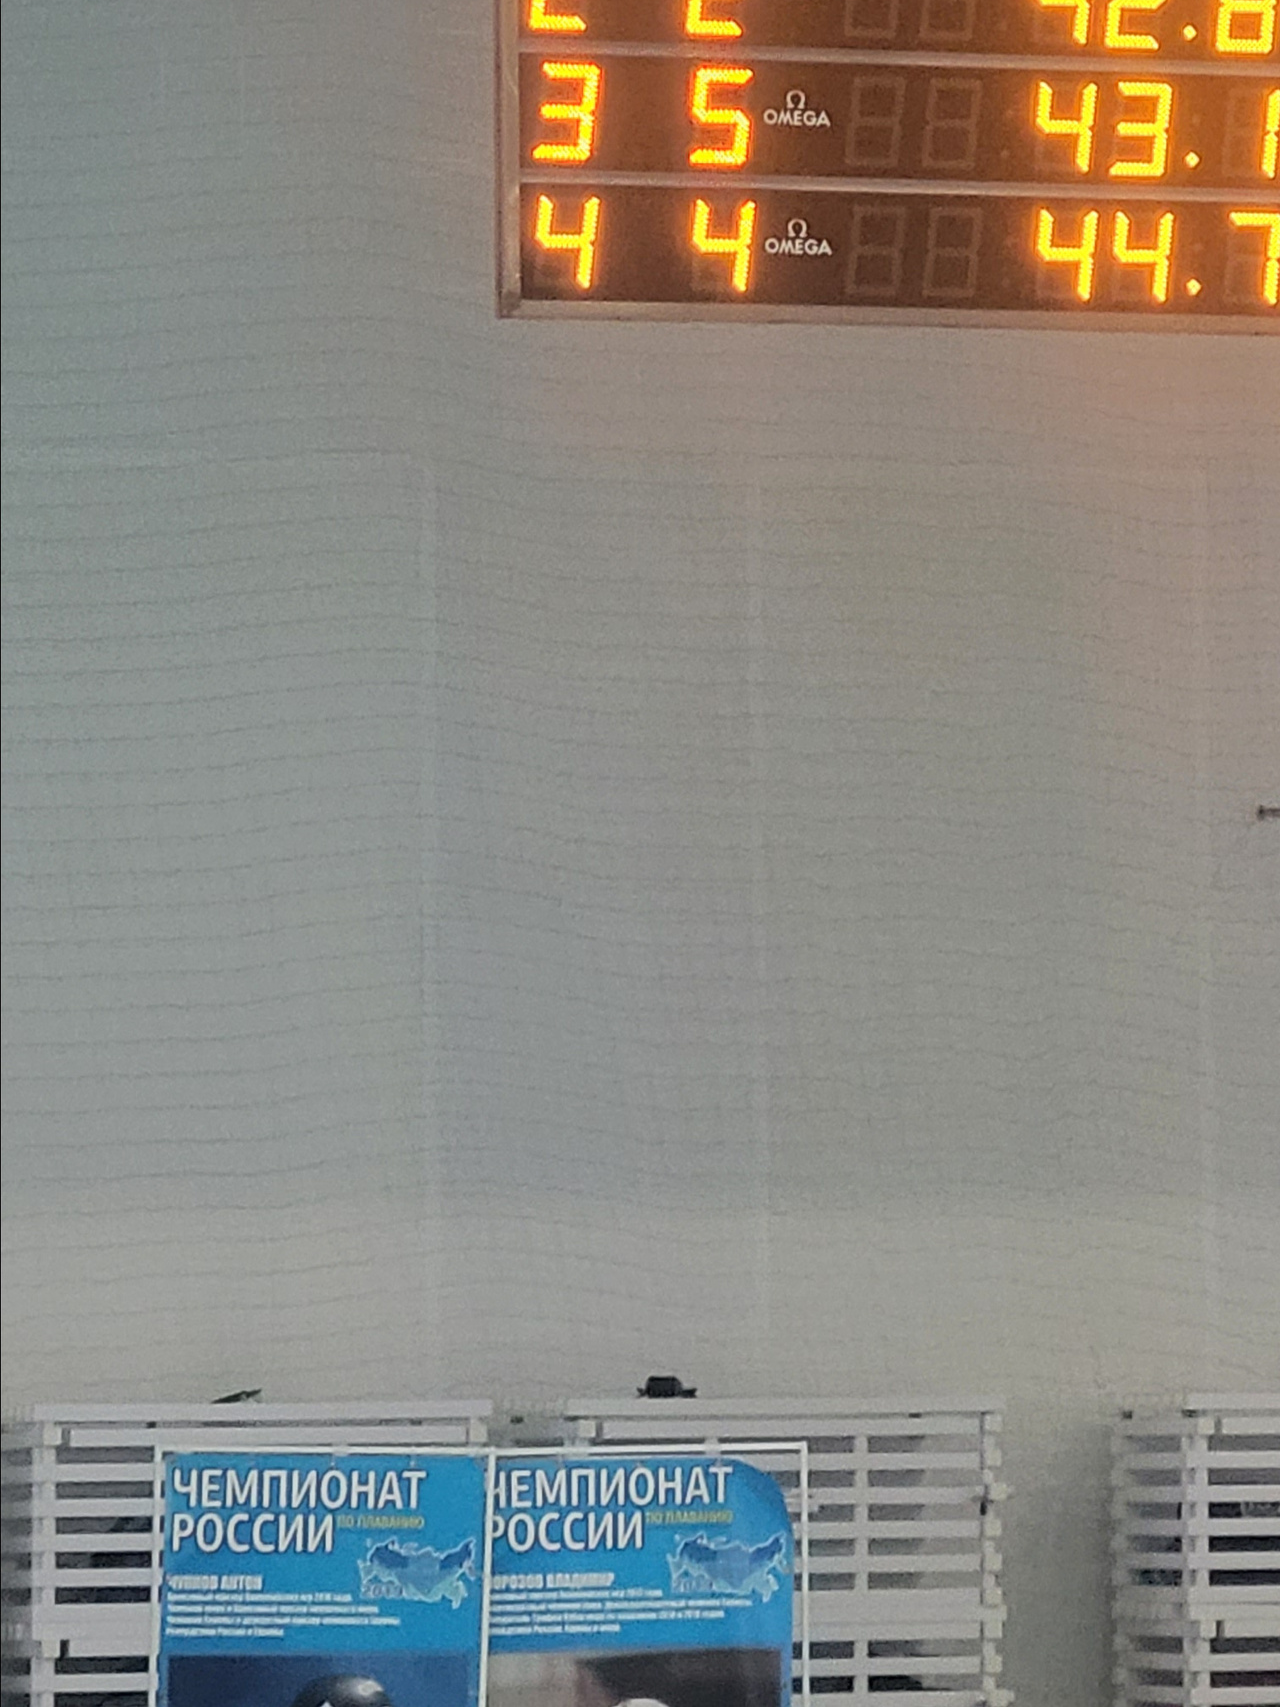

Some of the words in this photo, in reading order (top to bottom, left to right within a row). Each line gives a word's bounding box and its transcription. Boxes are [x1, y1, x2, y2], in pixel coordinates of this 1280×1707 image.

[533, 59, 605, 165] 3
[687, 63, 756, 170] 5
[763, 109, 831, 128] OMEGA
[532, 194, 603, 290] 4
[689, 198, 758, 293] 4
[764, 237, 833, 257] OMEGA
[173, 1468, 427, 1510] ЧЕМПИОНАТ
[172, 1512, 333, 1553] РОССИИ
